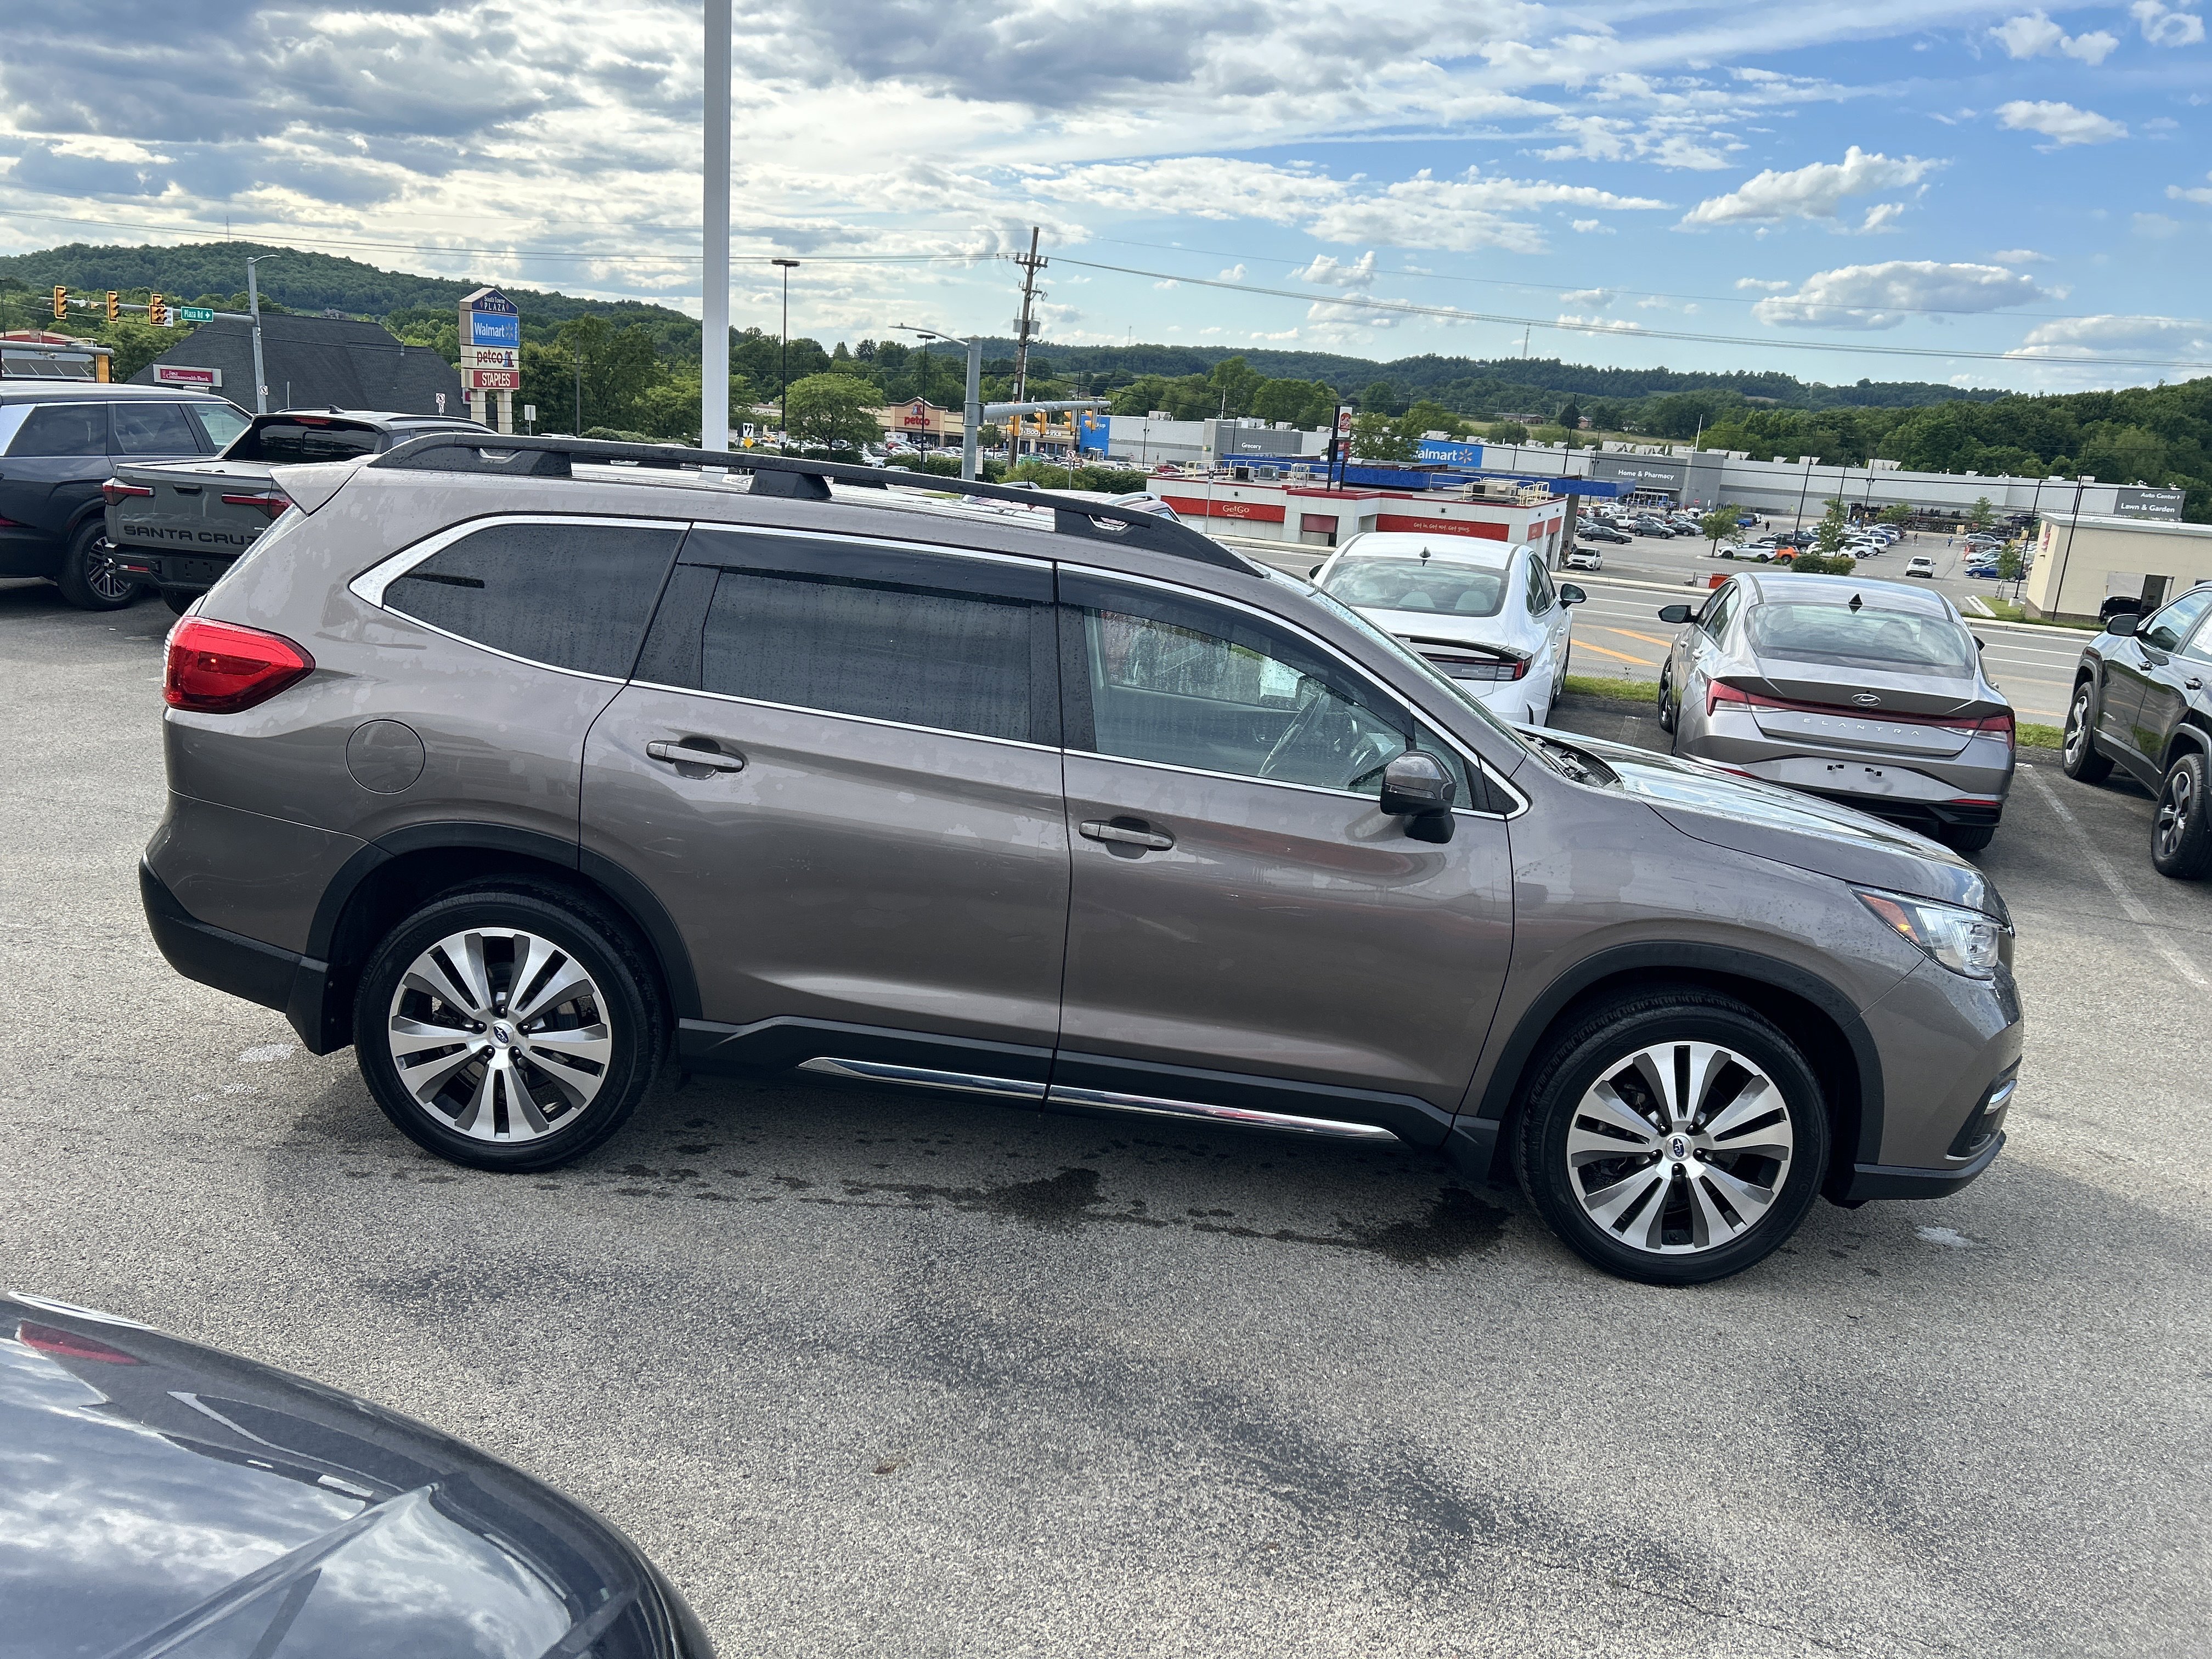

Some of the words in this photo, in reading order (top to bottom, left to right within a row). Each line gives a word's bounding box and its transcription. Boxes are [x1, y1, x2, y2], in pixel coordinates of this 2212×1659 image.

[184, 309, 196, 318] Plaza
[484, 302, 505, 312] PLAZA
[474, 323, 505, 337] Walmart
[477, 349, 503, 366] petco
[482, 373, 511, 387] STAPLES
[1410, 448, 1458, 461] almart
[1644, 471, 1674, 481] Pharmacy
[1222, 505, 1250, 514] GetGo
[2149, 505, 2175, 513] Garden
[123, 526, 193, 541] SANTA
[1803, 718, 1919, 736] ELANTRA
